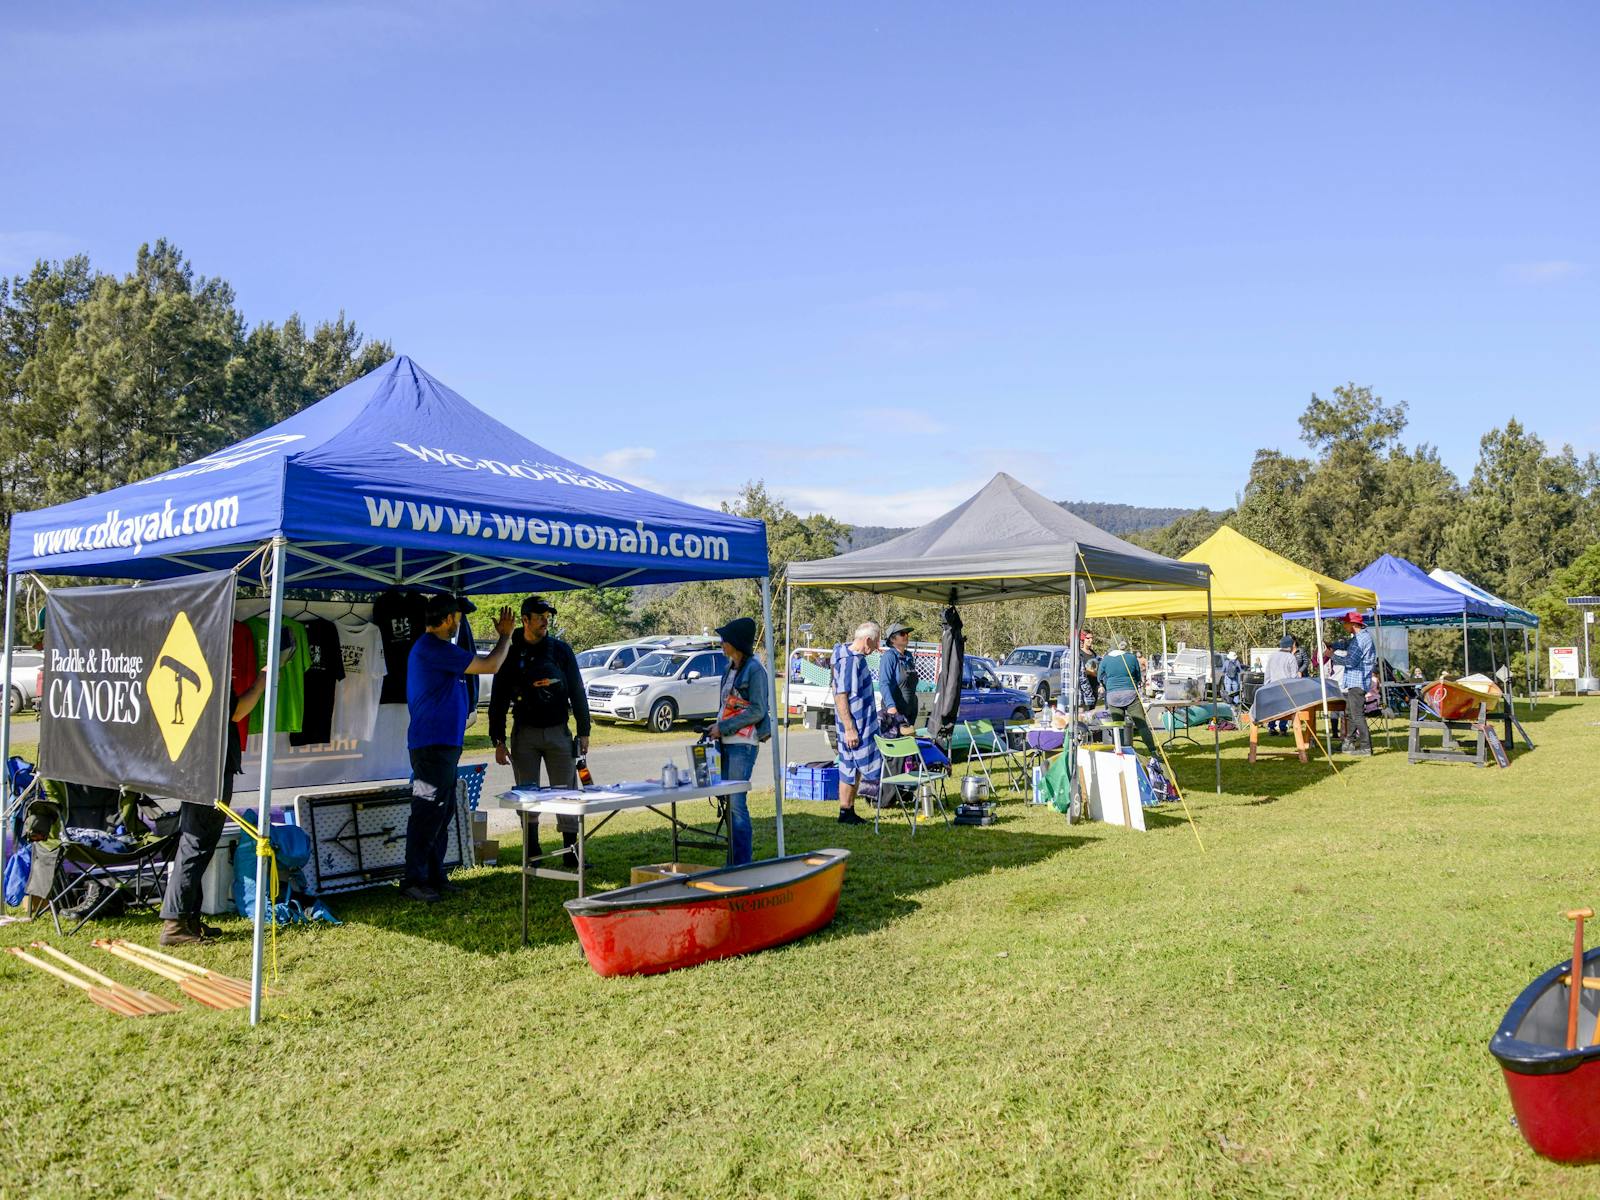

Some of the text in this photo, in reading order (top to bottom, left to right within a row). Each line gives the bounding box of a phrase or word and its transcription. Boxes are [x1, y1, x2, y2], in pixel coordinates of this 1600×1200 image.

[33, 495, 239, 555] www.cdkayak.com
[363, 496, 729, 561] www.wenonah.com
[50, 647, 143, 679] Paddle & Portage
[49, 678, 141, 724] CANOES
